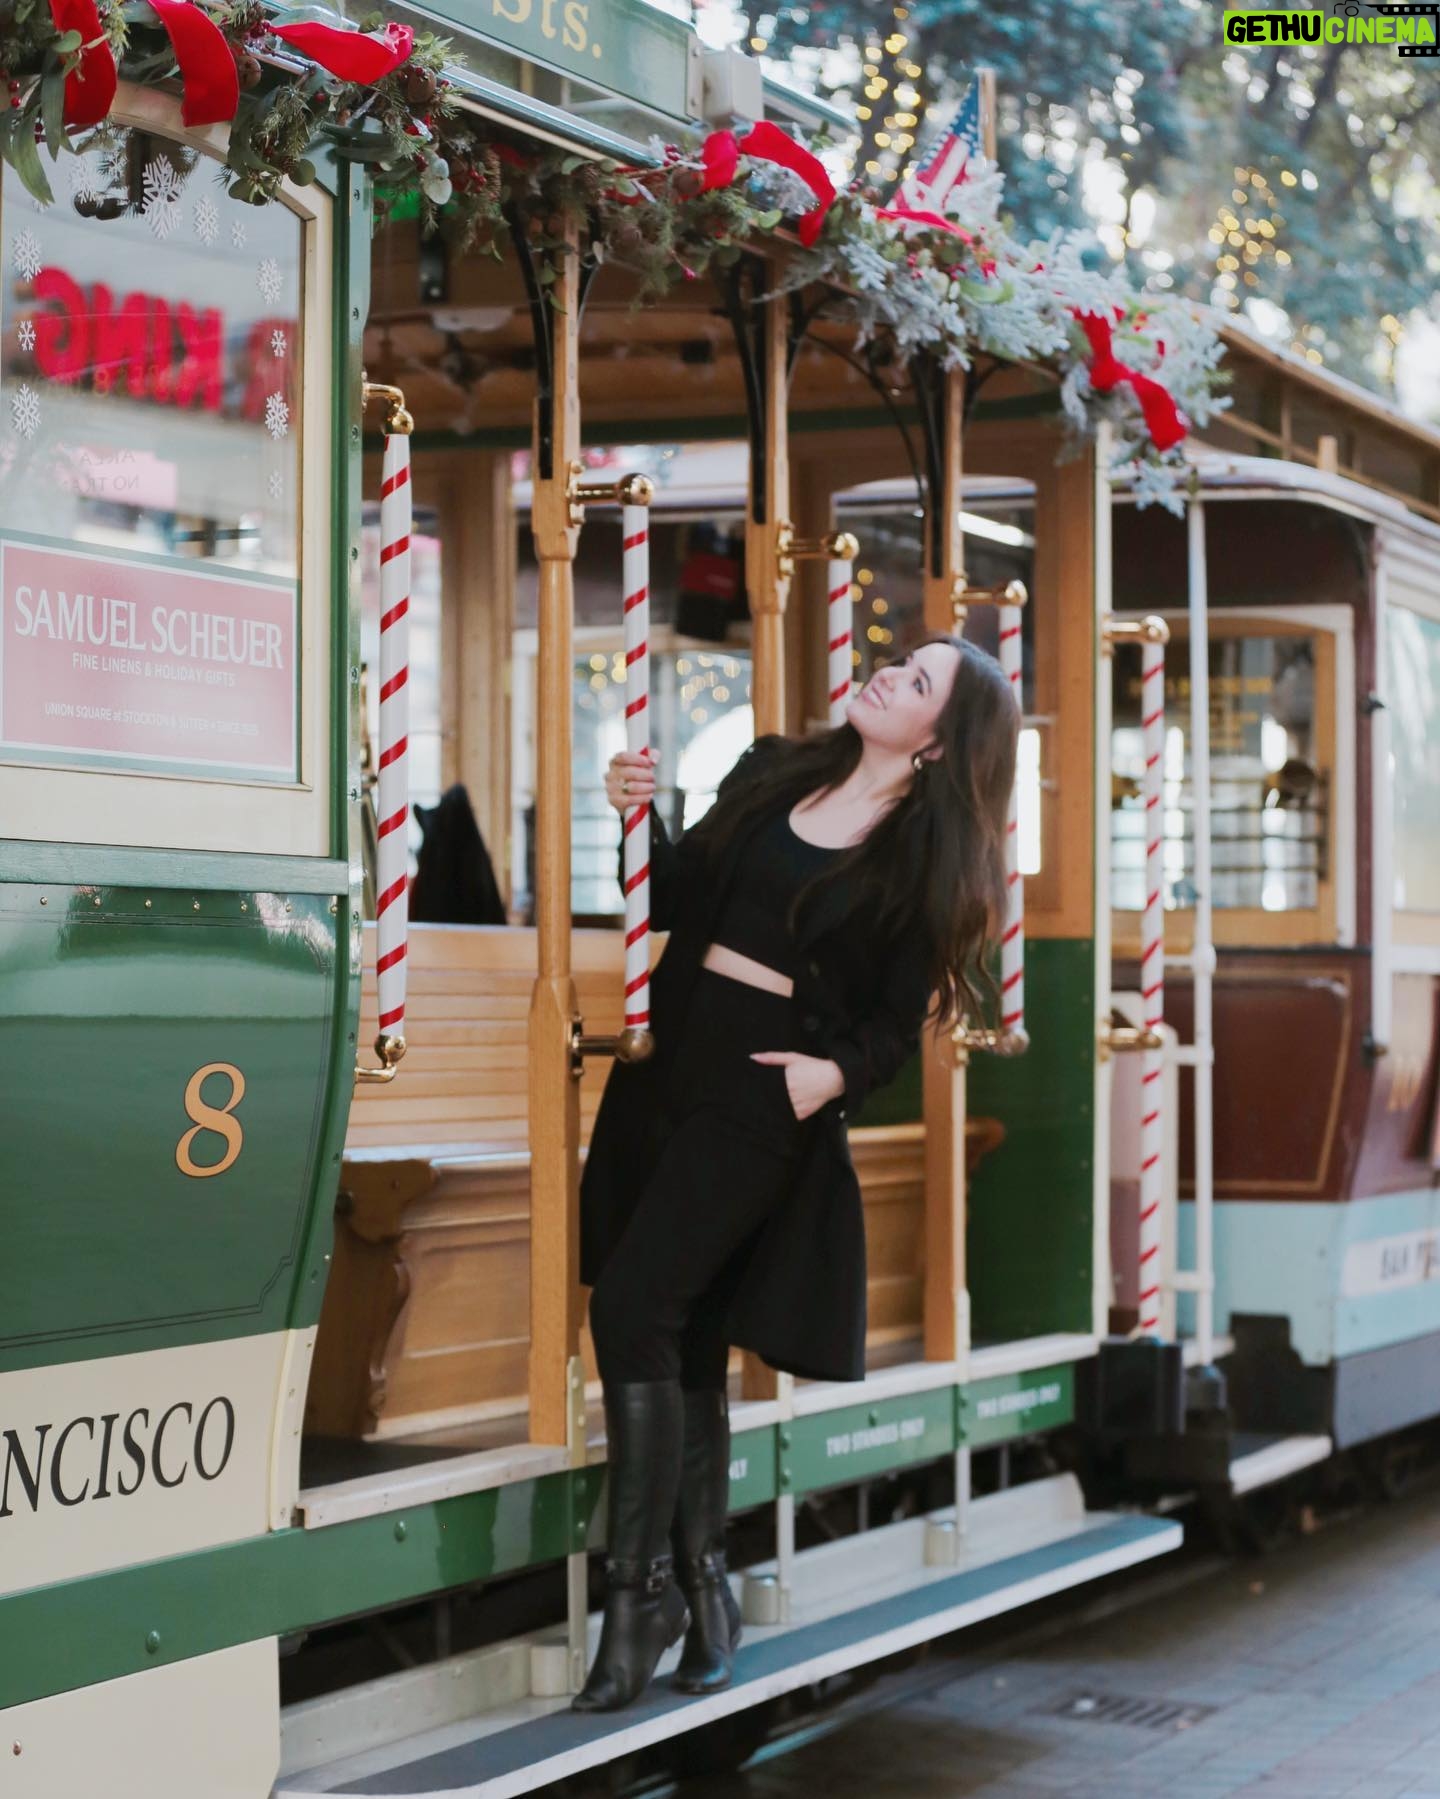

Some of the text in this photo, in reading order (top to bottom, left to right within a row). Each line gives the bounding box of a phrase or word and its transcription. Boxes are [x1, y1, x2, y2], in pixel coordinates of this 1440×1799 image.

[14, 585, 284, 670] SAMUEL SCHEUER
[72, 652, 99, 670] FINE
[102, 656, 142, 675] LINENS
[154, 664, 202, 682] HOLIDAY
[206, 669, 236, 688] GIFTS
[45, 703, 74, 717] UNION
[76, 705, 112, 721] SQUARE
[174, 1060, 247, 1179] 8
[0, 1395, 236, 1518] NCISCO
